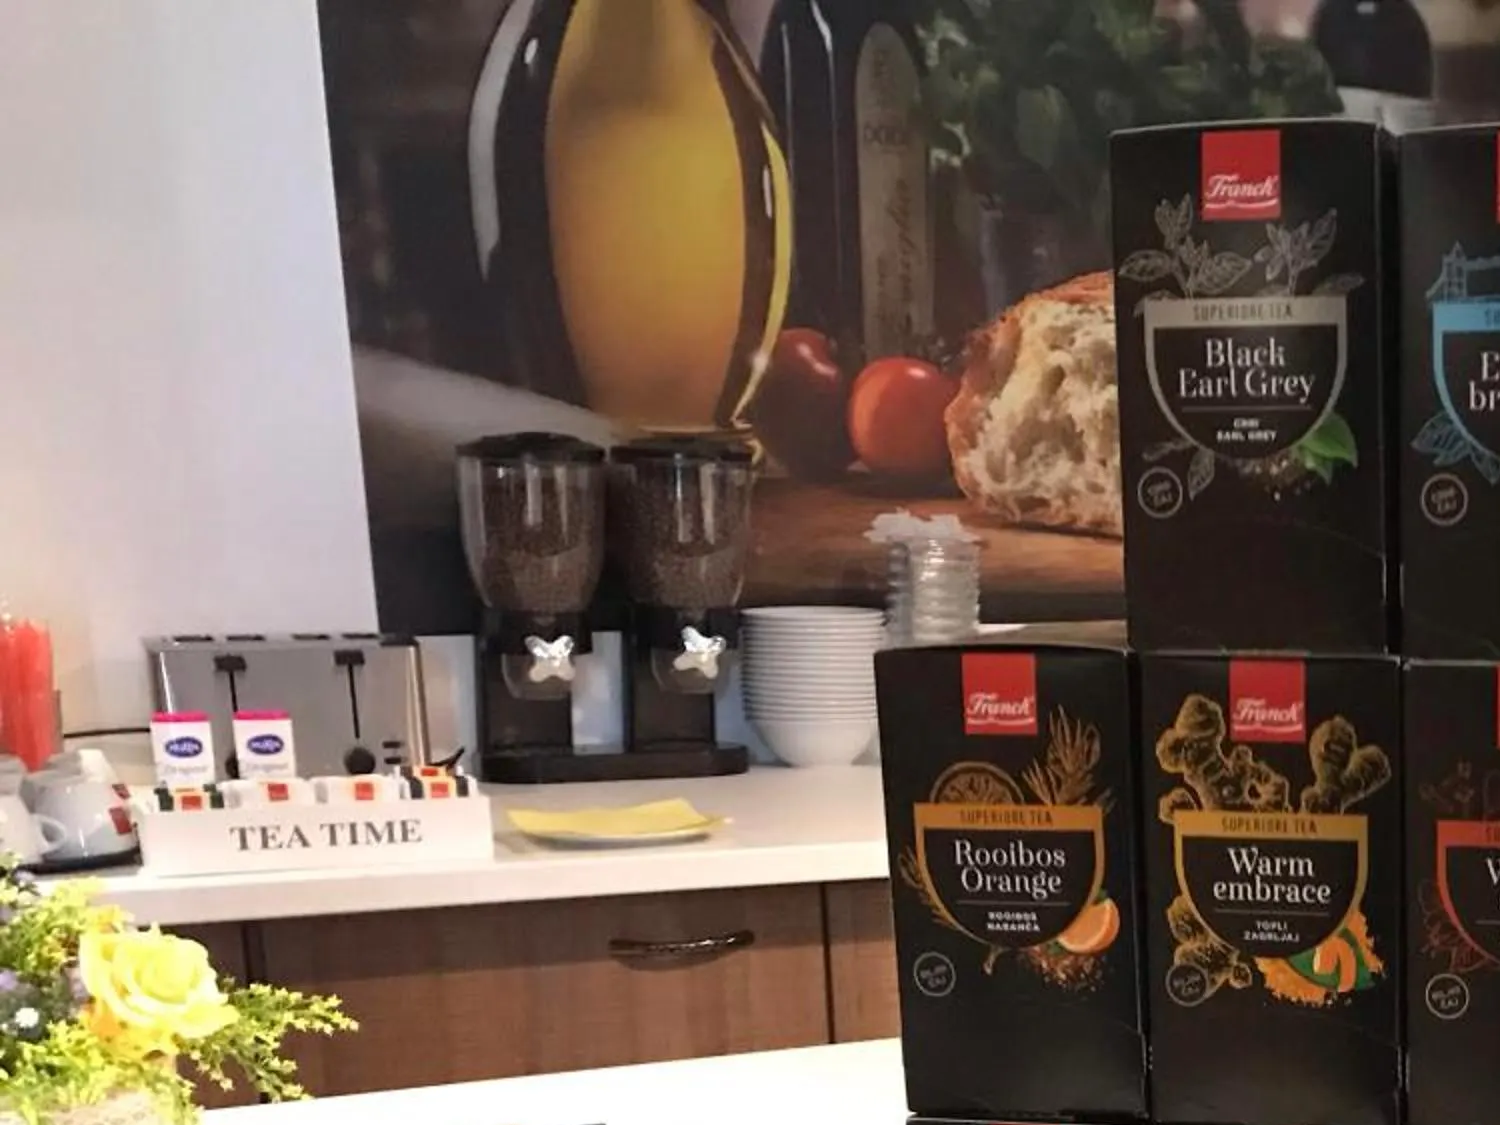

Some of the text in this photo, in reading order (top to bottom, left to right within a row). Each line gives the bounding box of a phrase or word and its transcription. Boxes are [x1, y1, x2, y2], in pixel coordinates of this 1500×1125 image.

[1206, 174, 1279, 198] Franck
[1268, 303, 1293, 318] TEA
[1205, 337, 1286, 368] Black
[1179, 368, 1315, 404] Earl Grey
[967, 692, 1036, 716] Franck
[1233, 698, 1304, 722] Franck
[1028, 809, 1054, 825] TEA
[1292, 817, 1318, 834] TEA
[229, 818, 424, 852] TEA TIME
[954, 839, 1067, 867] Rooibos
[1227, 846, 1316, 877] Warm
[960, 866, 1062, 900] Orange
[1212, 874, 1332, 904] embrace
